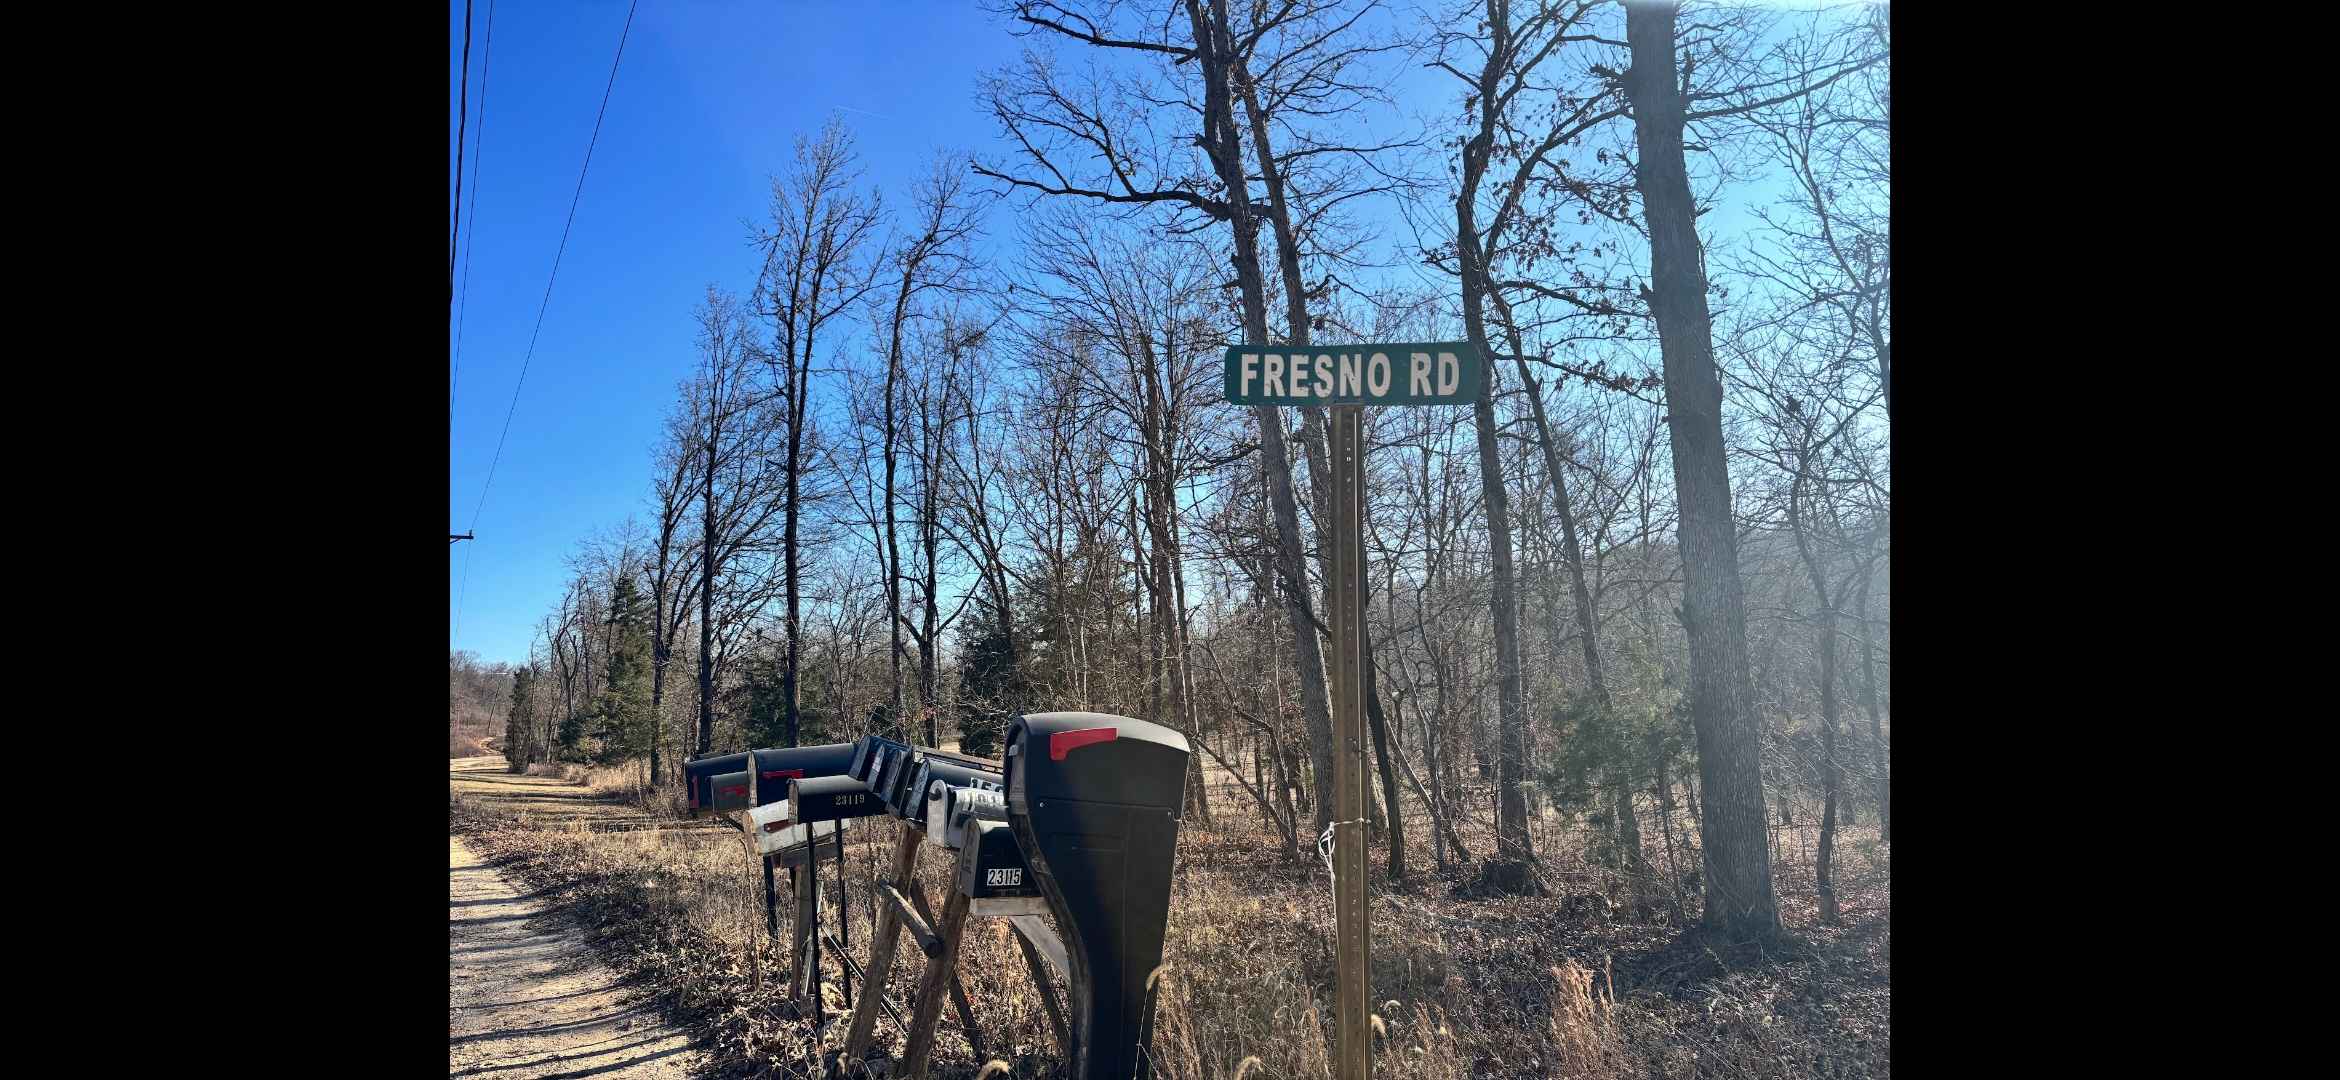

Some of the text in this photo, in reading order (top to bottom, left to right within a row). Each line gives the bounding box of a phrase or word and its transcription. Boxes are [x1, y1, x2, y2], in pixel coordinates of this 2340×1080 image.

[1240, 352, 1460, 398] FRESNO RD
[835, 794, 865, 805] 23119
[988, 869, 1021, 885] 23115
